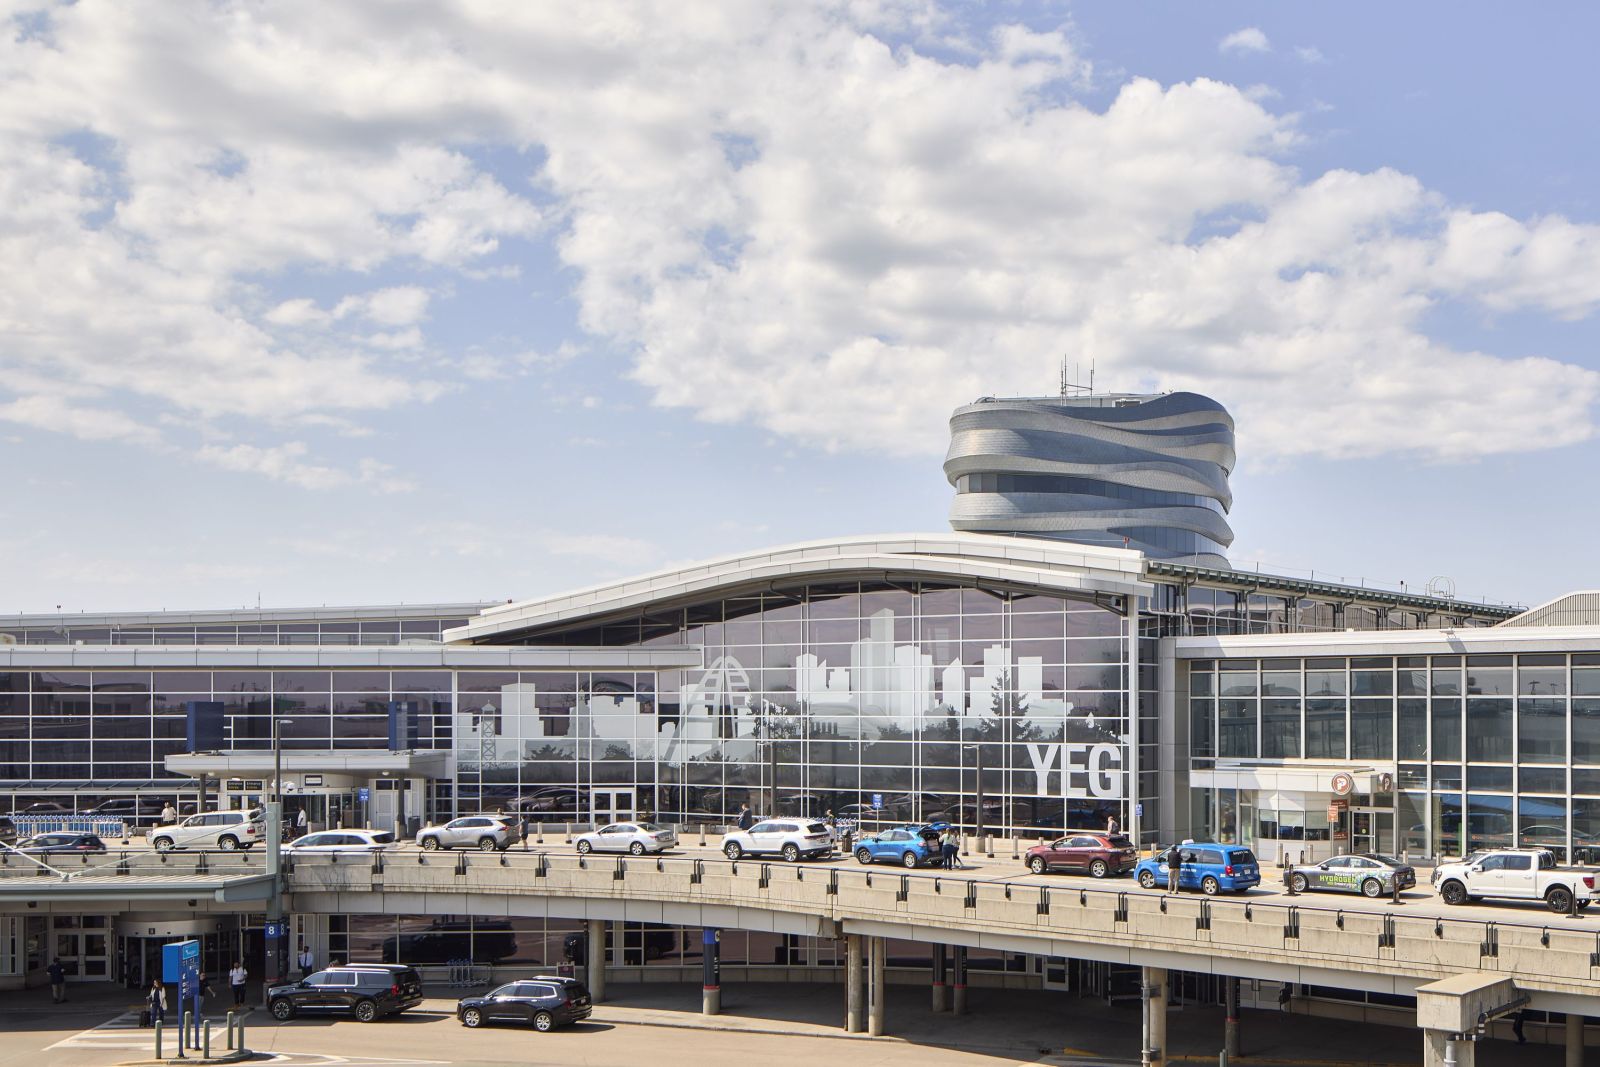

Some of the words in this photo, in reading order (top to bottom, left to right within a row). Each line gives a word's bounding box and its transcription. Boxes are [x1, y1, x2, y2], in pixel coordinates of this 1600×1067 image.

[1026, 743, 1121, 798] YEG
[1319, 875, 1356, 883] HYDROGEN
[268, 926, 275, 935] 8
